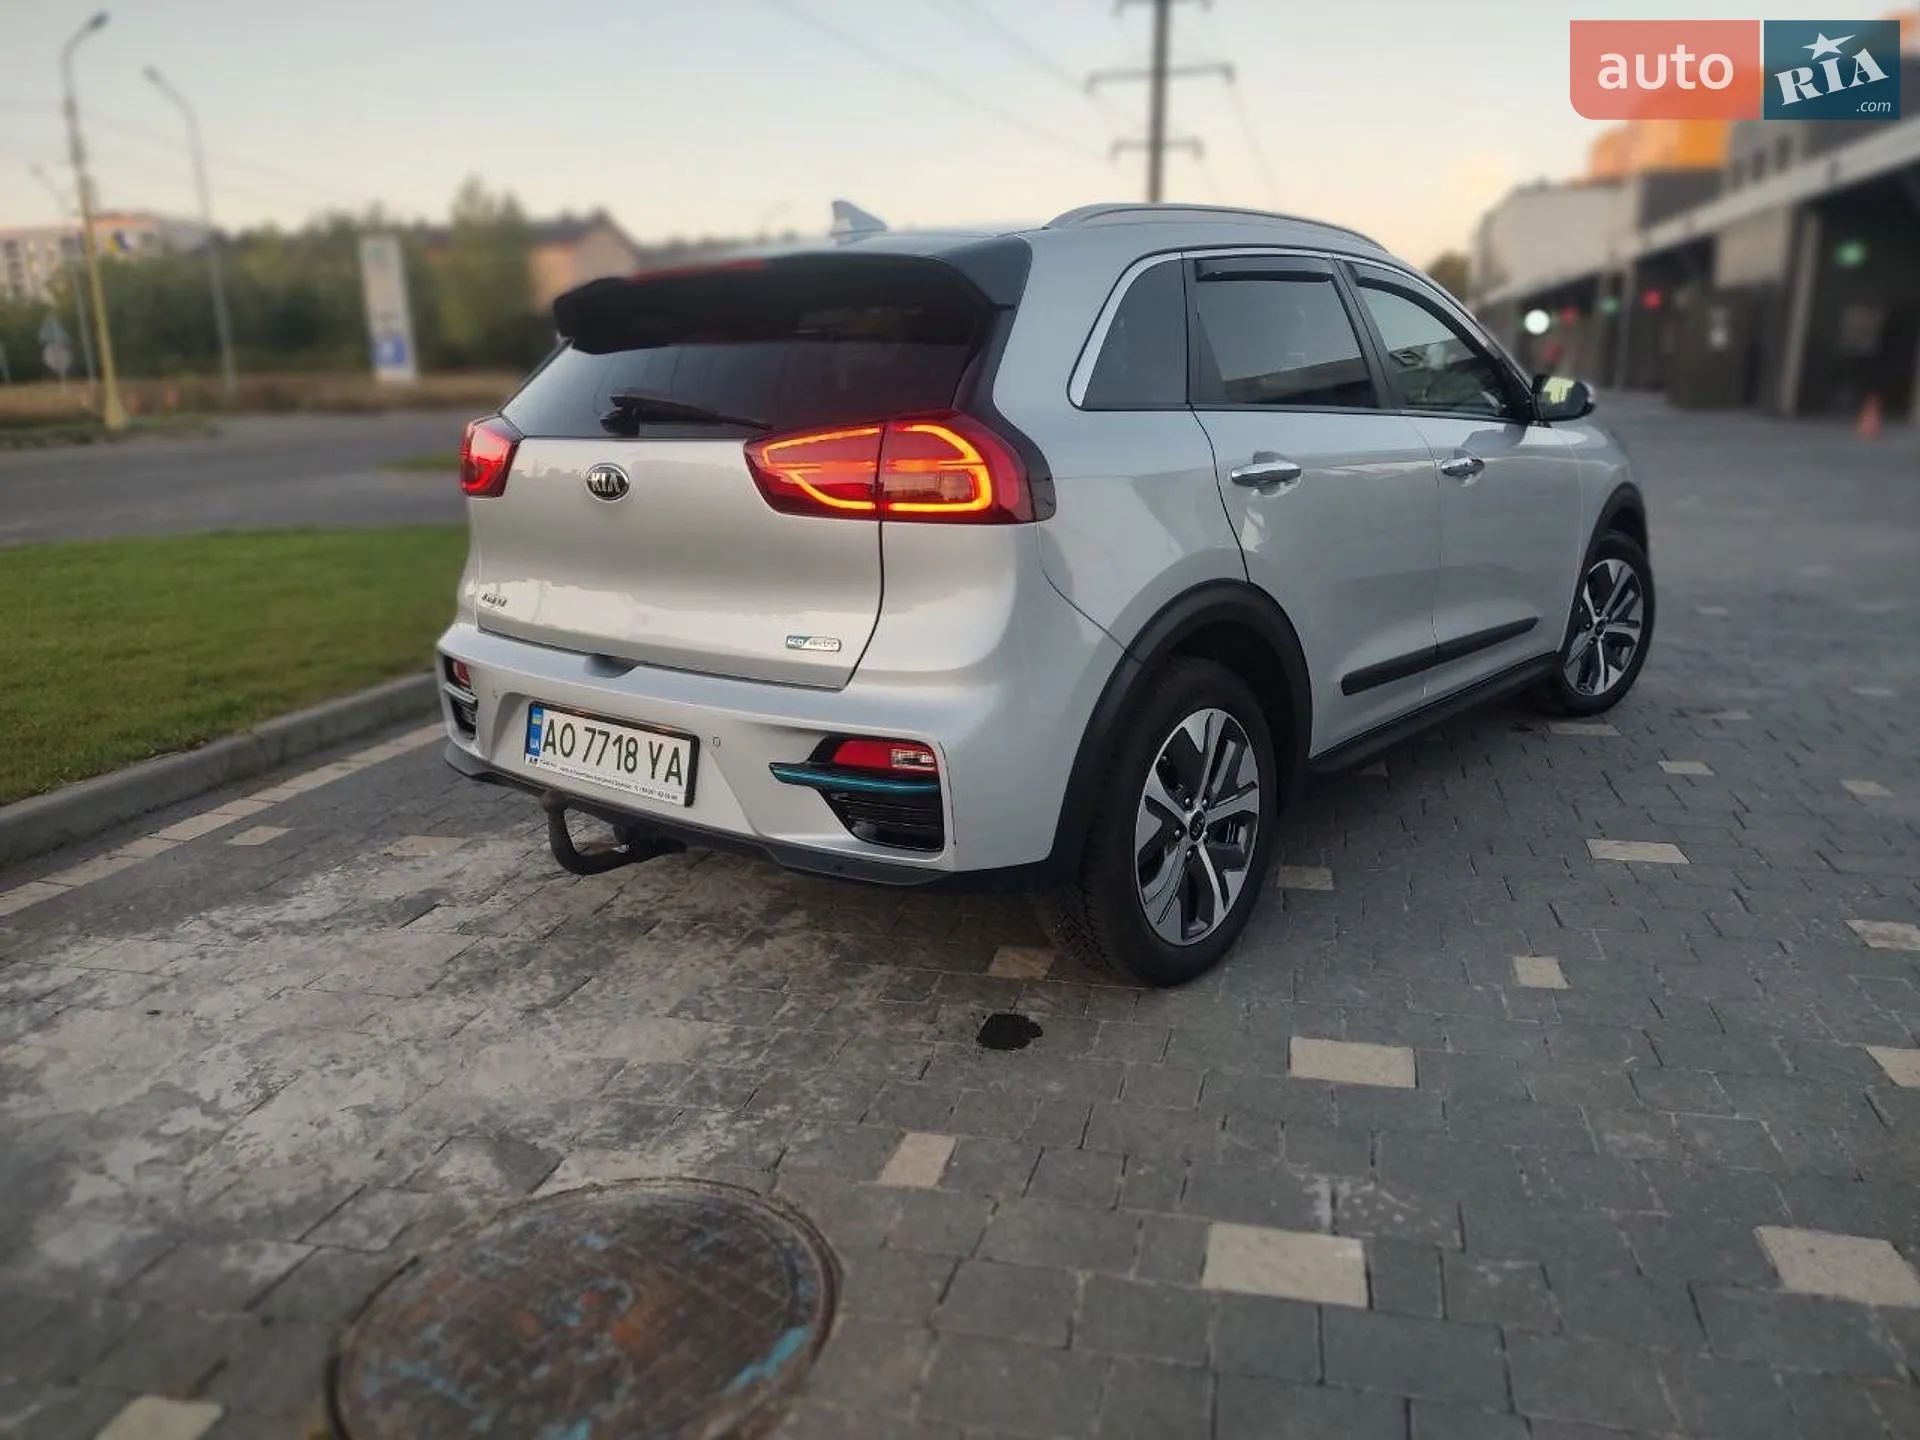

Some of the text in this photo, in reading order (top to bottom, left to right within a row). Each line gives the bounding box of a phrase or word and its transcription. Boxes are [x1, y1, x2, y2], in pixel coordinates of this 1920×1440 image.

[591, 472, 621, 492] KIA
[542, 718, 683, 786] AO 7718 YA
